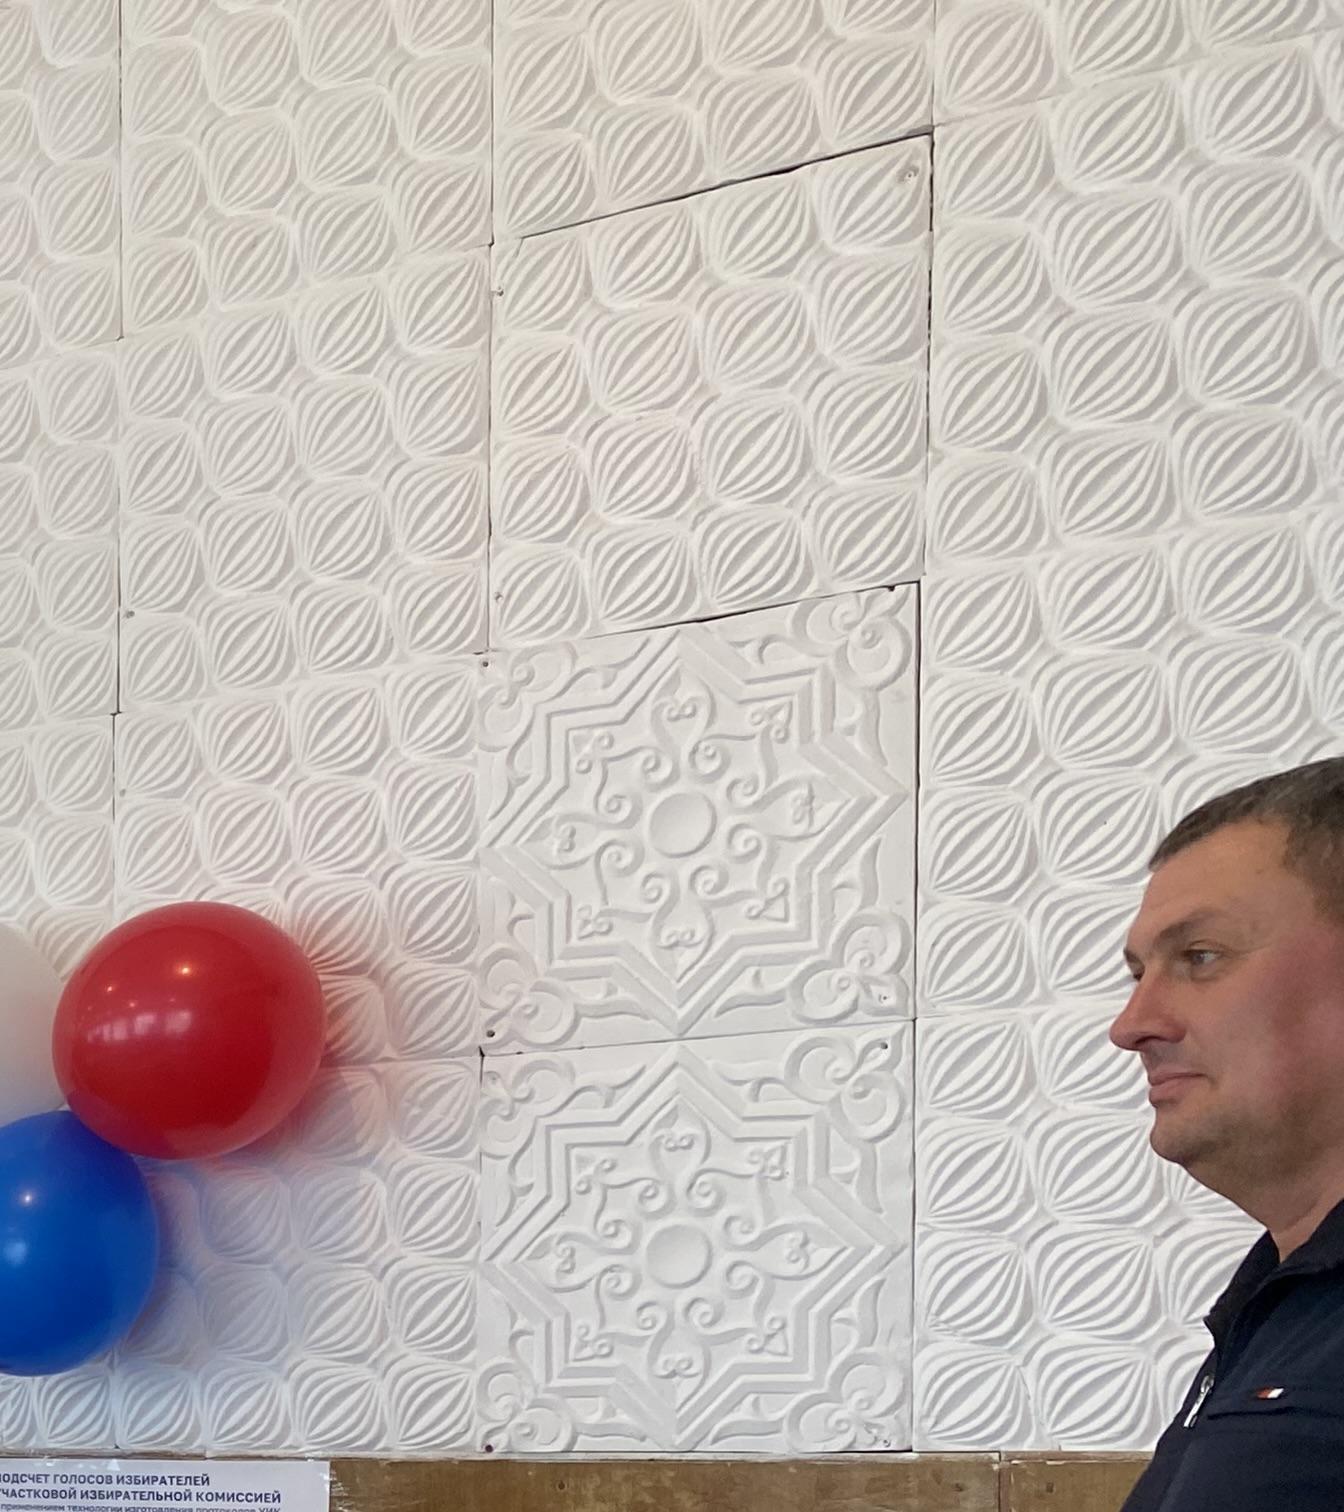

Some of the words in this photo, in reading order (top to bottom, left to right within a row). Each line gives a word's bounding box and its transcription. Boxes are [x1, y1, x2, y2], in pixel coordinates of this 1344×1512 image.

[54, 1474, 113, 1485] ГОЛОСОВ
[116, 1473, 210, 1486] ИЗБИРАТЕЛЕЙ
[80, 1489, 192, 1501] ИЗБИРАТЕЛЬНОЙ
[196, 1490, 281, 1504] КОМИССИЕЙ
[0, 1503, 65, 1512] применением
[67, 1504, 122, 1512] технологии
